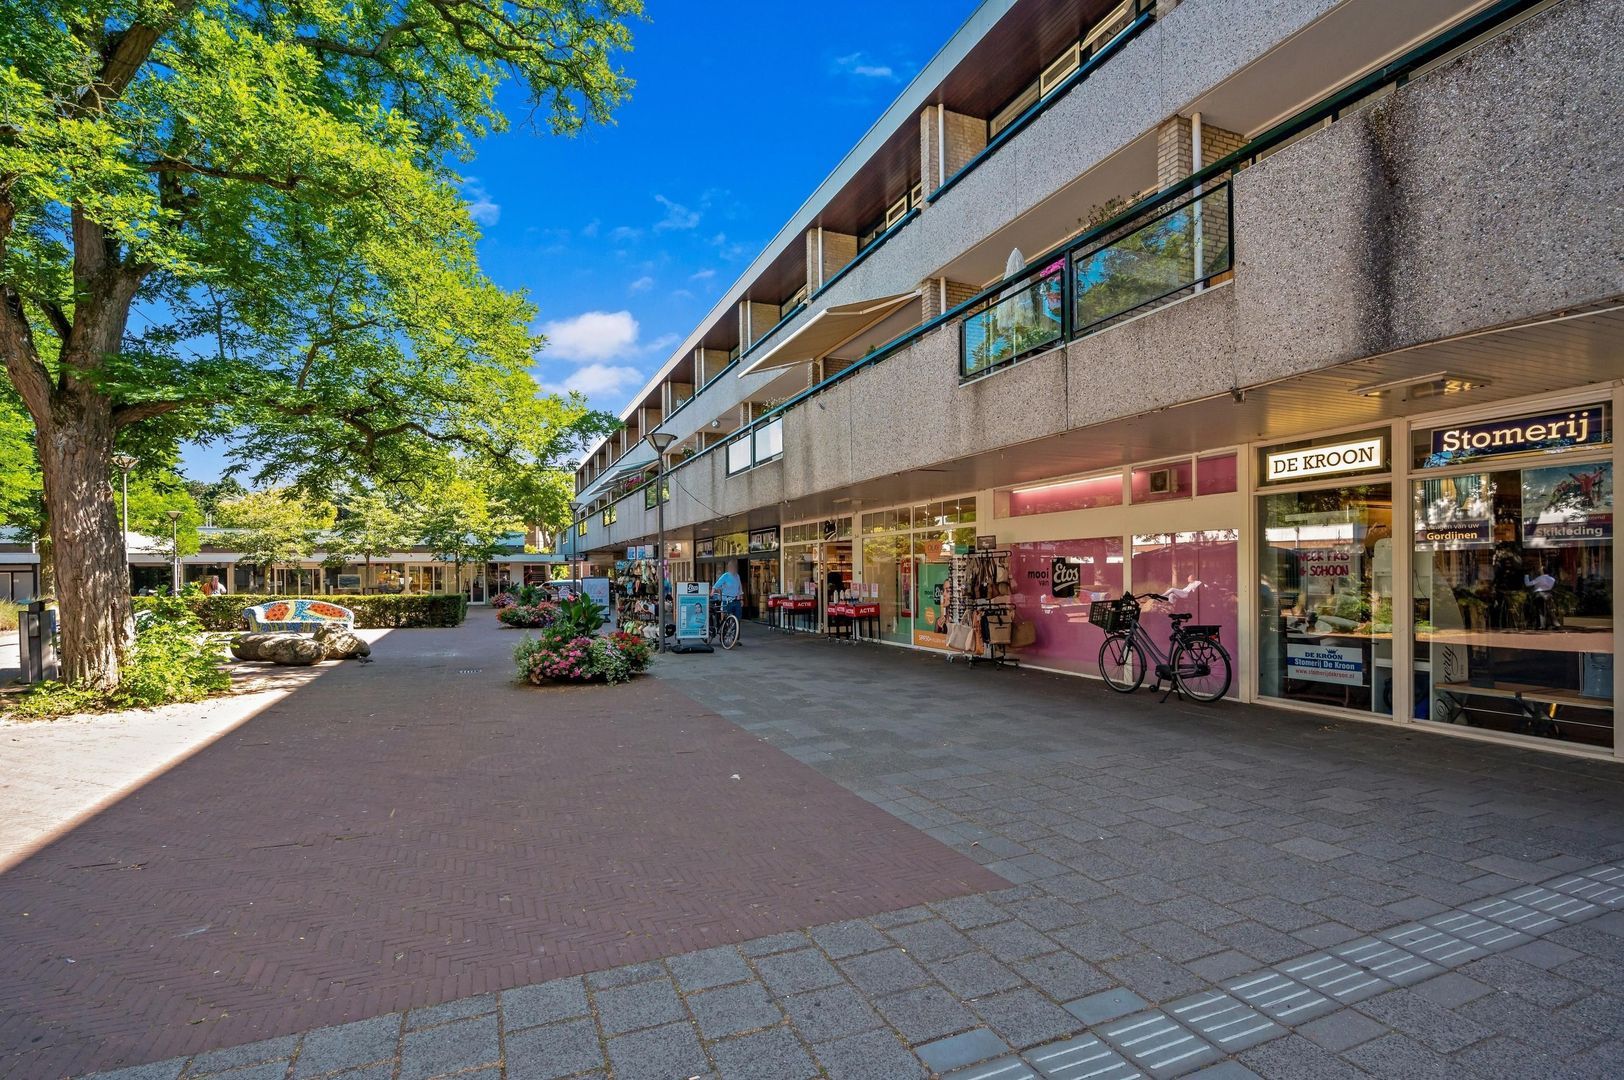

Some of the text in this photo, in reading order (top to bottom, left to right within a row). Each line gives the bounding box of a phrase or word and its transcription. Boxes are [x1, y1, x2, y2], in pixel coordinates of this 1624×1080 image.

[1443, 411, 1588, 452] Stomerij
[1273, 446, 1375, 474] DE KROON
[1426, 531, 1478, 541] Gordijnen
[1535, 526, 1604, 537] Skikleding
[1027, 567, 1050, 579] mooi
[1053, 562, 1079, 583] Etos
[1309, 564, 1349, 577] SCHOON
[1316, 652, 1343, 660] KROON
[1294, 658, 1355, 670] Stomerij De Kroon
